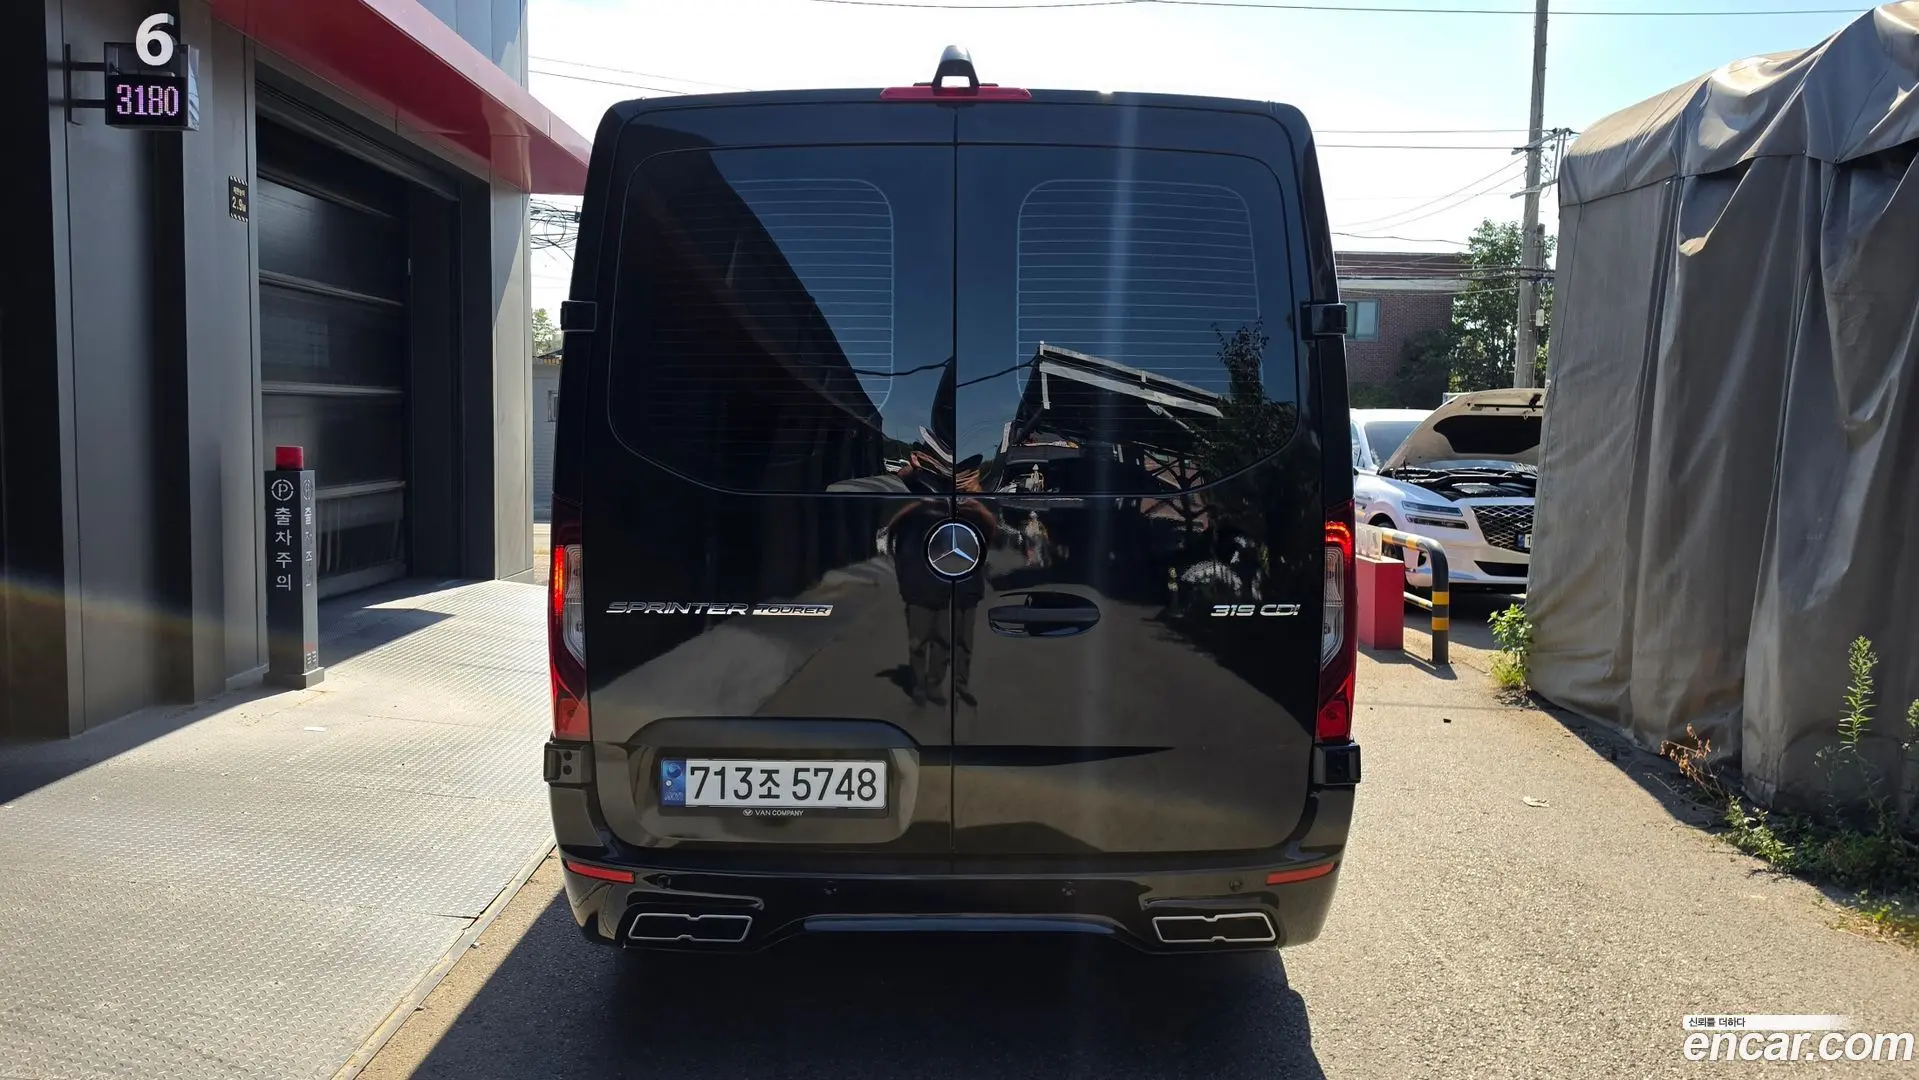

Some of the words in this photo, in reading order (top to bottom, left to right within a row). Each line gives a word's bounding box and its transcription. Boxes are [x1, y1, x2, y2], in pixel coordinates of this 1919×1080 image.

[136, 13, 174, 66] 6
[116, 84, 179, 116] 3180
[274, 507, 293, 591] 출차주의
[606, 601, 749, 615] SPRINTER
[756, 604, 831, 616] TOURER
[1210, 604, 1256, 617] 319
[1260, 604, 1301, 616] CDI
[690, 766, 780, 800] 713조
[792, 767, 877, 801] 5748
[771, 809, 804, 817] COMPANY
